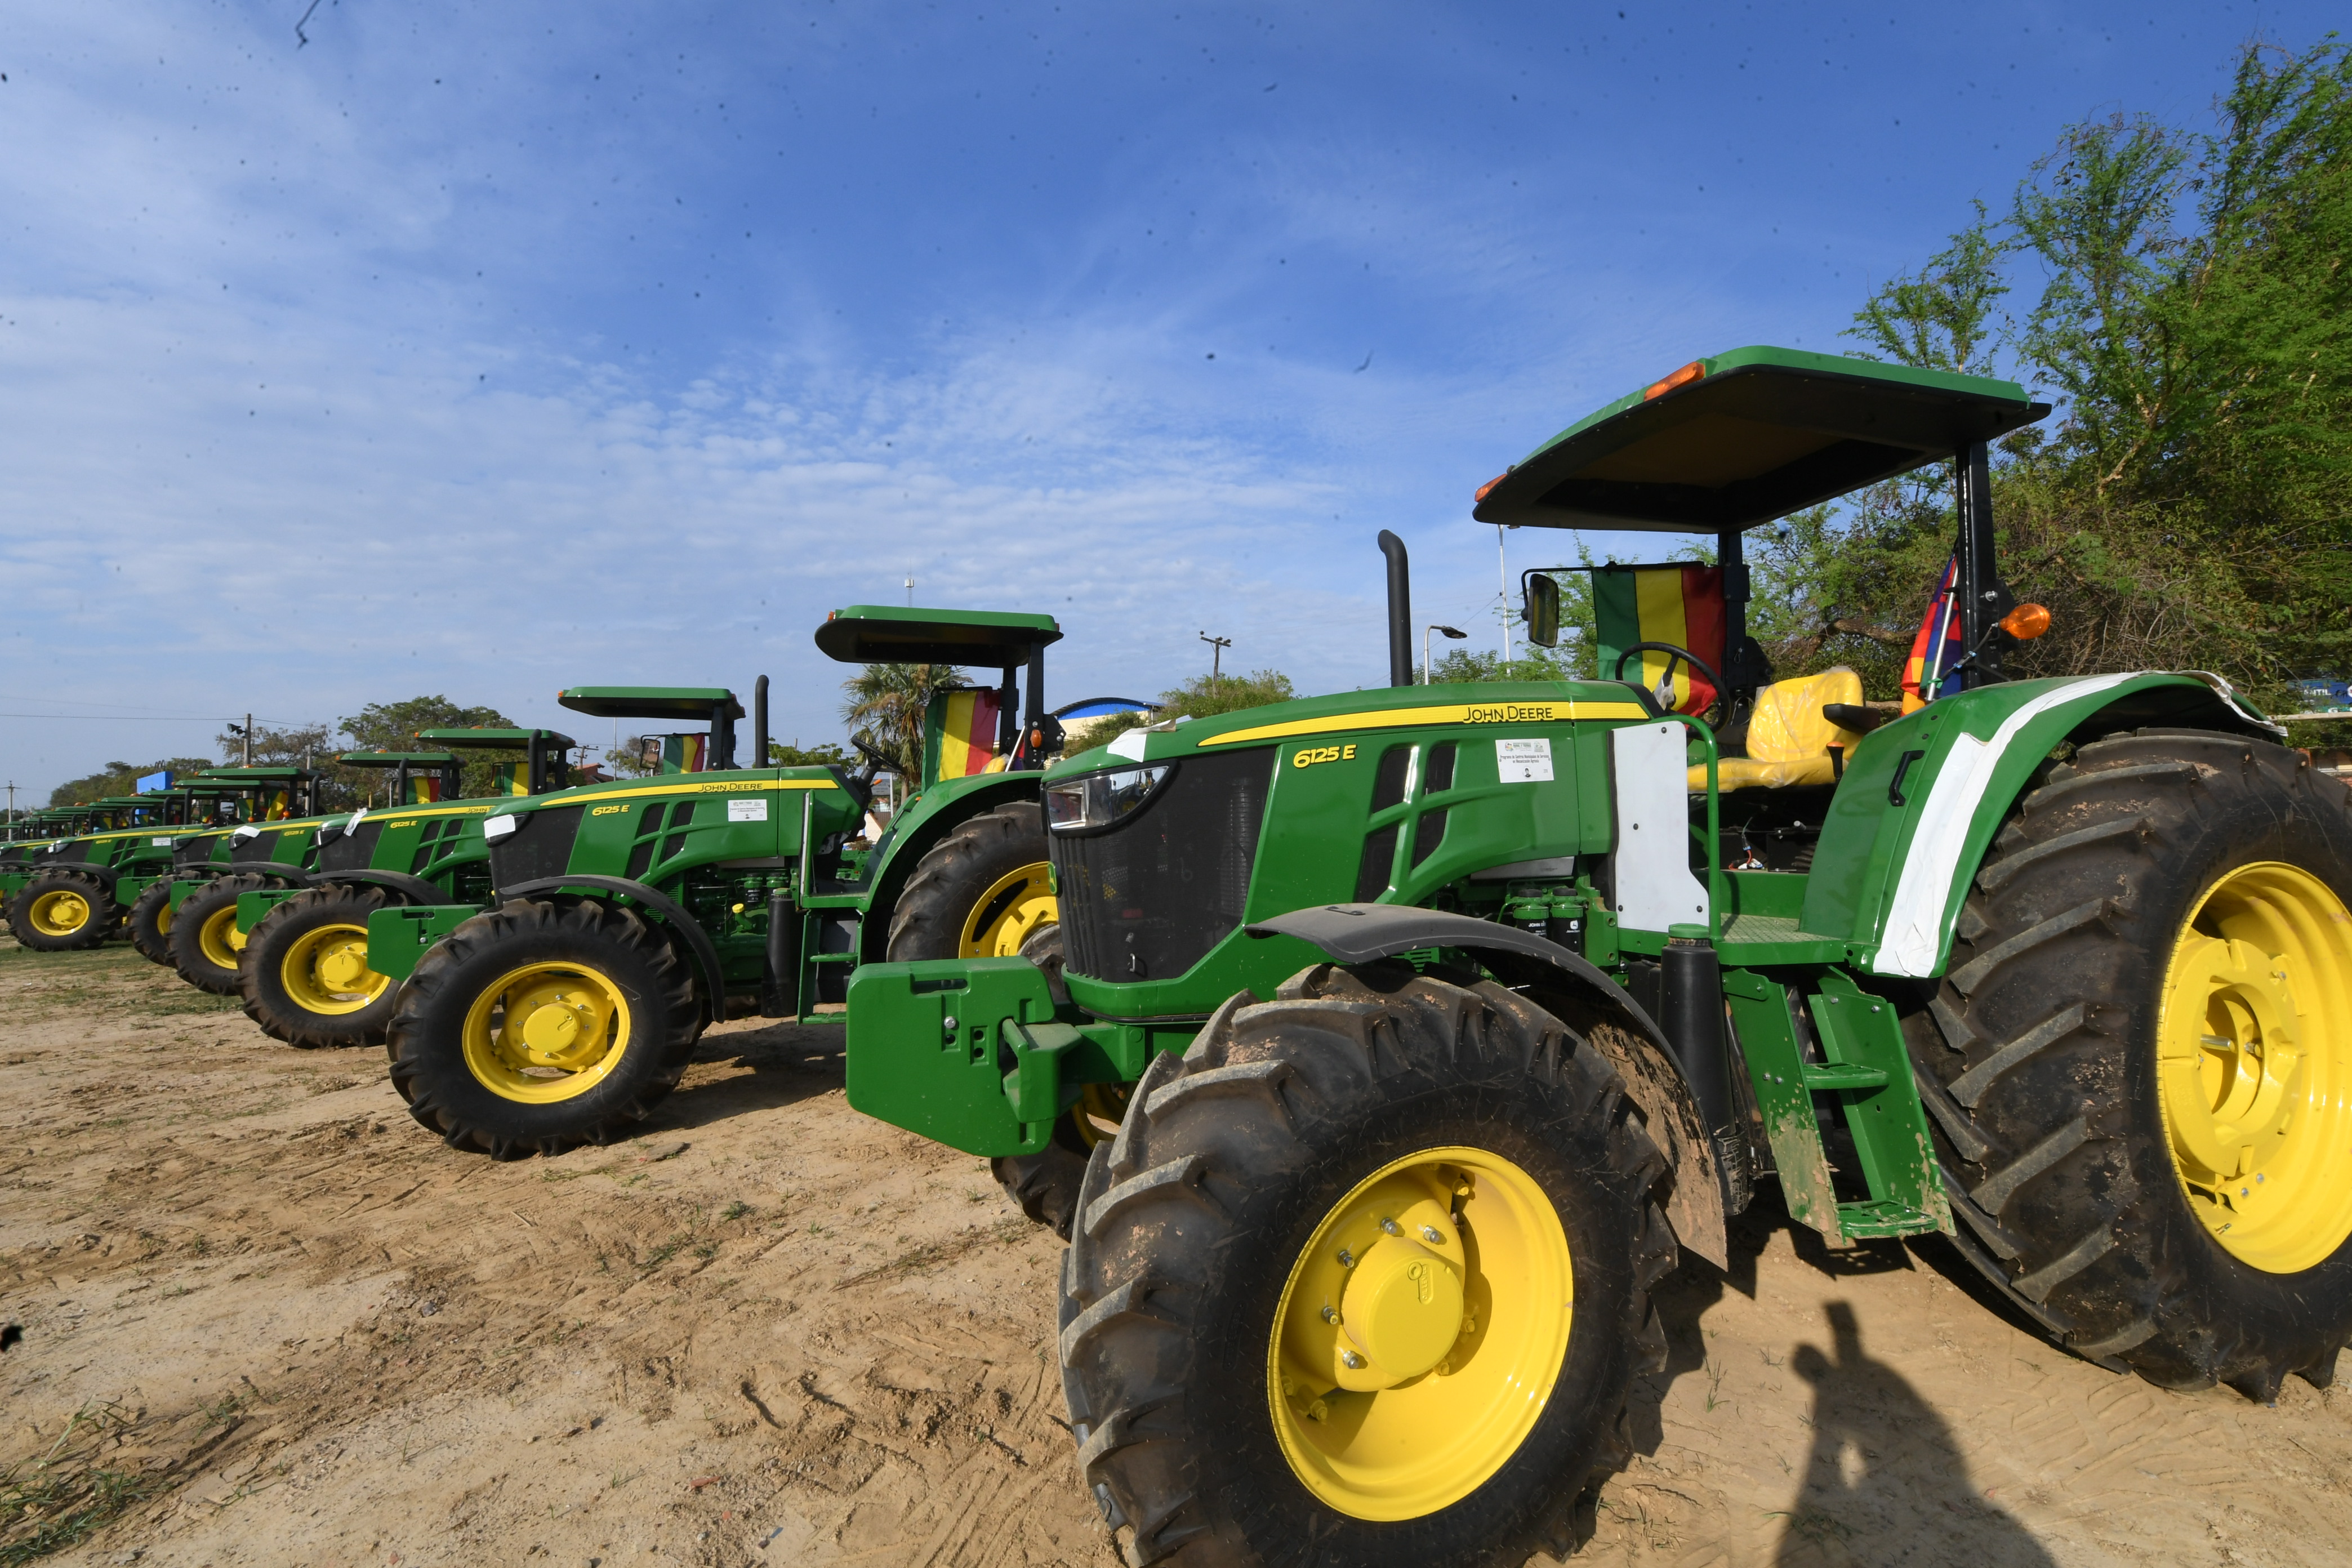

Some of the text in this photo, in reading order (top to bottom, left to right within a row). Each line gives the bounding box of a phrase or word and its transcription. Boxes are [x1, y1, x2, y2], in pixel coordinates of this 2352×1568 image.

[1463, 706, 1553, 721] JOHN DEERE
[1293, 744, 1357, 768] 6125 E
[592, 805, 620, 816] 6125
